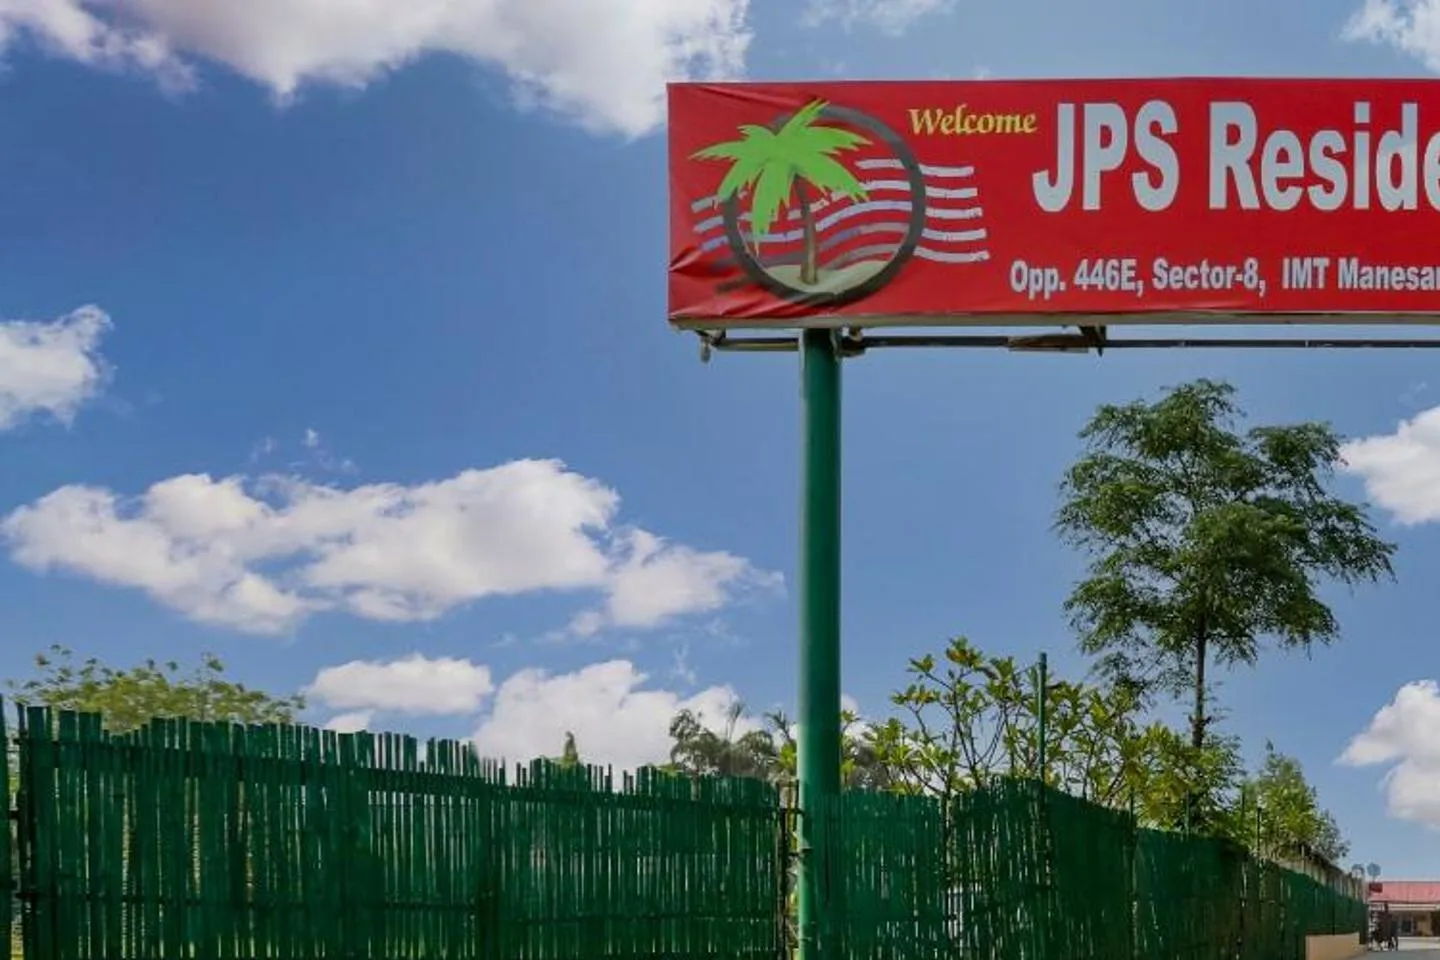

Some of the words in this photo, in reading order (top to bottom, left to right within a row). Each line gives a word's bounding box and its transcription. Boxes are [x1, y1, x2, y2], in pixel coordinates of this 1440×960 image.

[909, 105, 1037, 135] Welcome
[1032, 100, 1179, 212] JPS
[1010, 259, 1067, 300] Opp.
[1074, 260, 1143, 297] 446E,
[1152, 258, 1266, 297] Sector-8,
[1282, 258, 1328, 290] IMT
